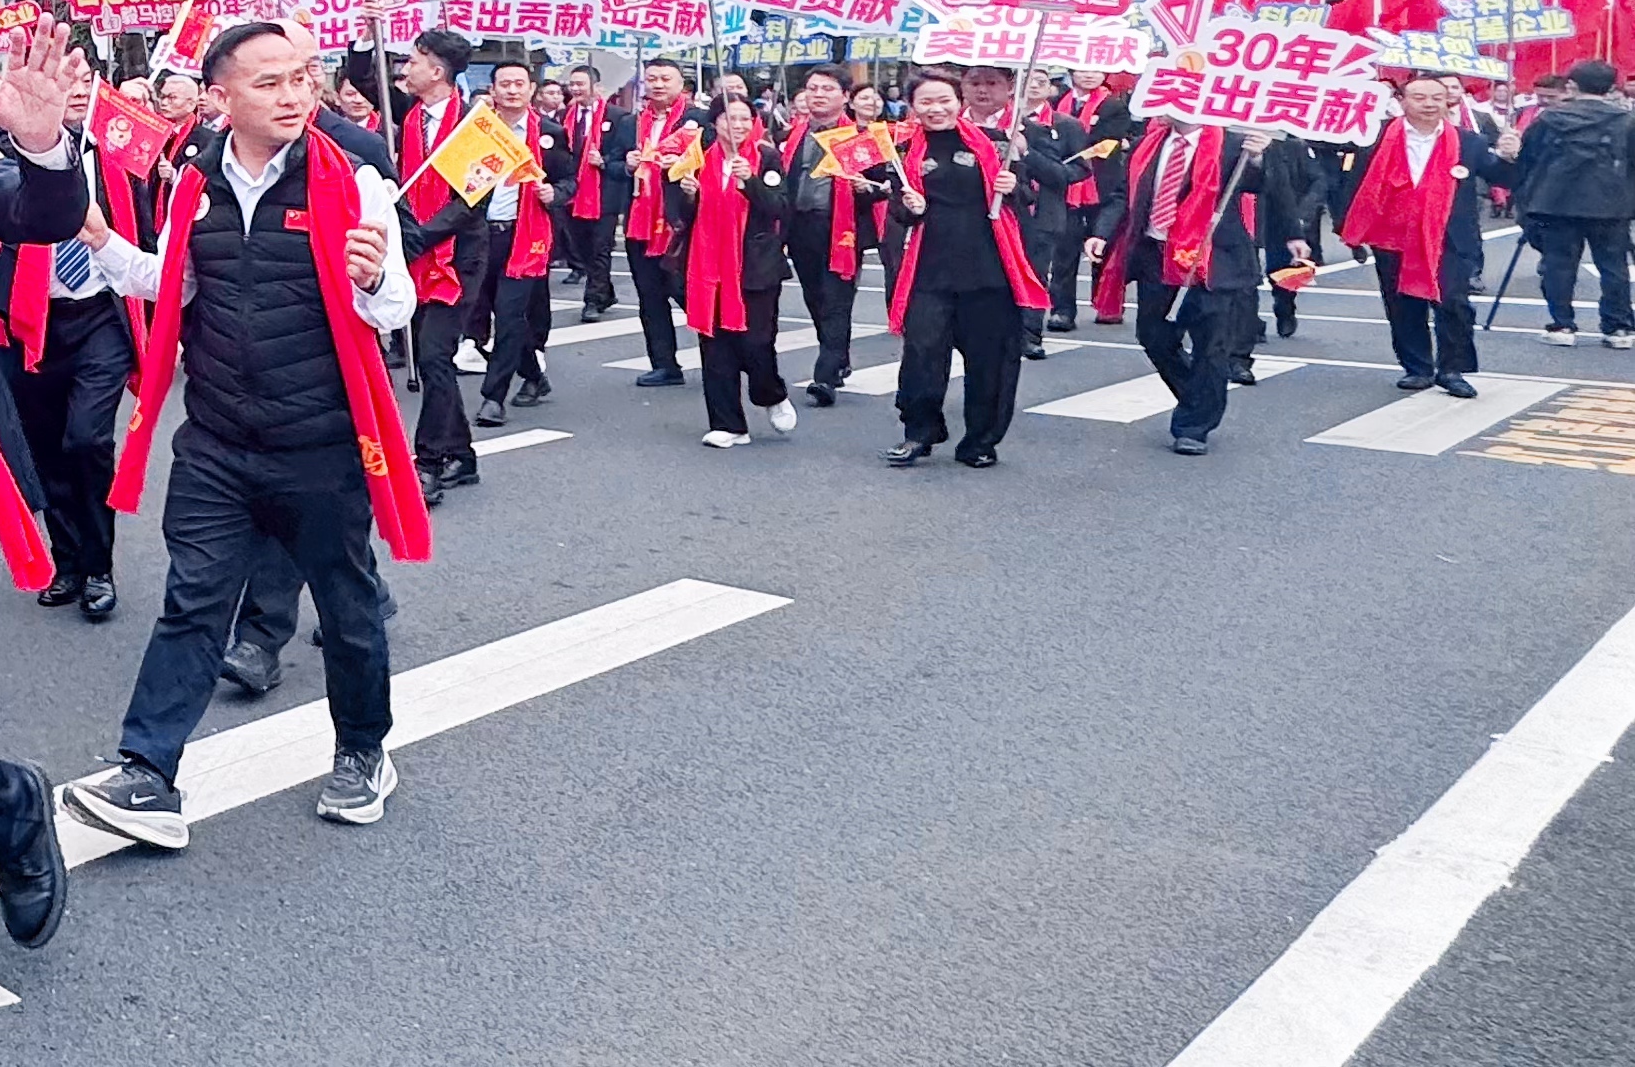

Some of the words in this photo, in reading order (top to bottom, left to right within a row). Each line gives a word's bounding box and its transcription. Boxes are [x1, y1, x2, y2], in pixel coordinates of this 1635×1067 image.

[739, 38, 829, 65] 新星企业
[924, 29, 1138, 67] 突出贡献
[1207, 29, 1337, 81] 30年
[1142, 67, 1379, 137] 突出贡献
